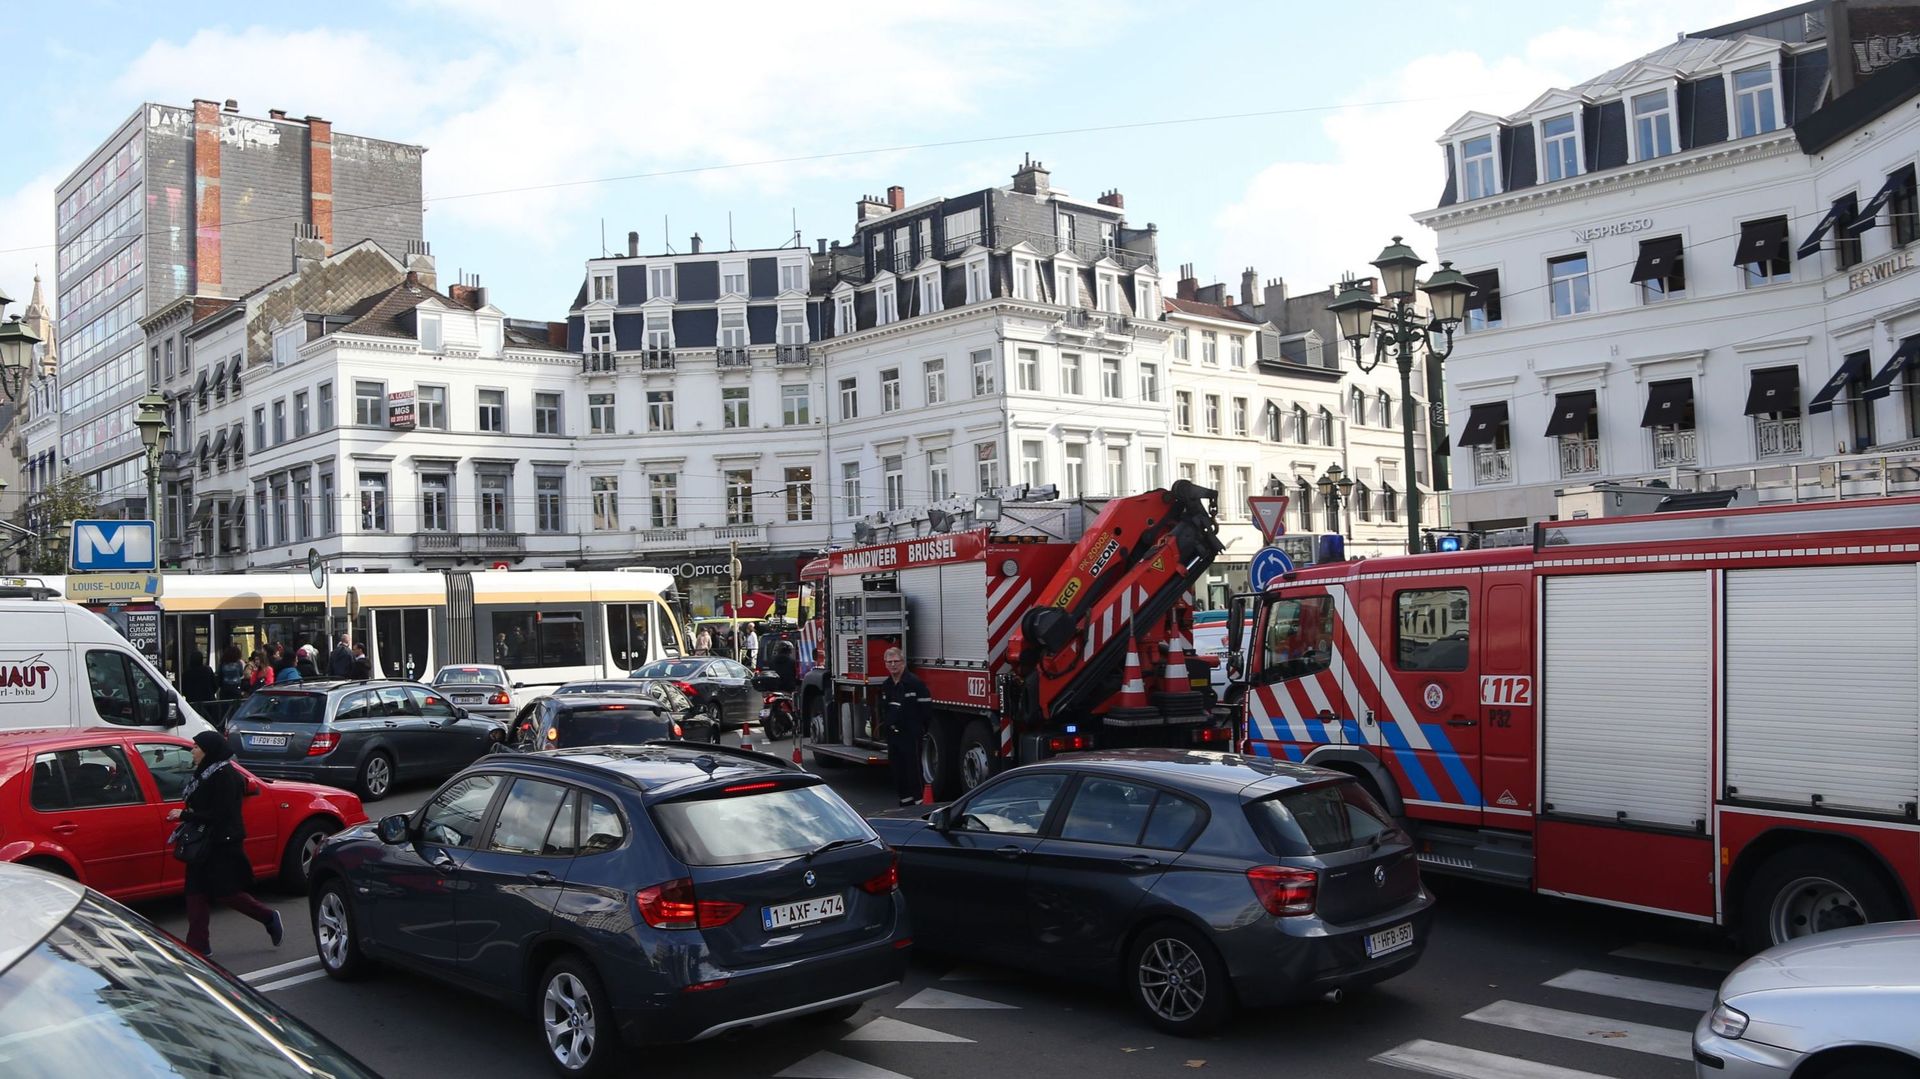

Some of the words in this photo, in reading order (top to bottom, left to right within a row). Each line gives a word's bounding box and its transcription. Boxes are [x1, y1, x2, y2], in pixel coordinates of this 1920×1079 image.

[1572, 217, 1653, 243] NESPRESSO
[395, 406, 410, 415] MGS
[908, 539, 957, 562] BRUSSEL
[1087, 531, 1110, 559] 20002
[843, 547, 897, 570] BRANDWEER
[1090, 540, 1119, 577] DEOM
[268, 604, 279, 613] 92
[15, 688, 35, 696] bvba
[1492, 678, 1530, 703] 112
[1488, 709, 1512, 728] P32
